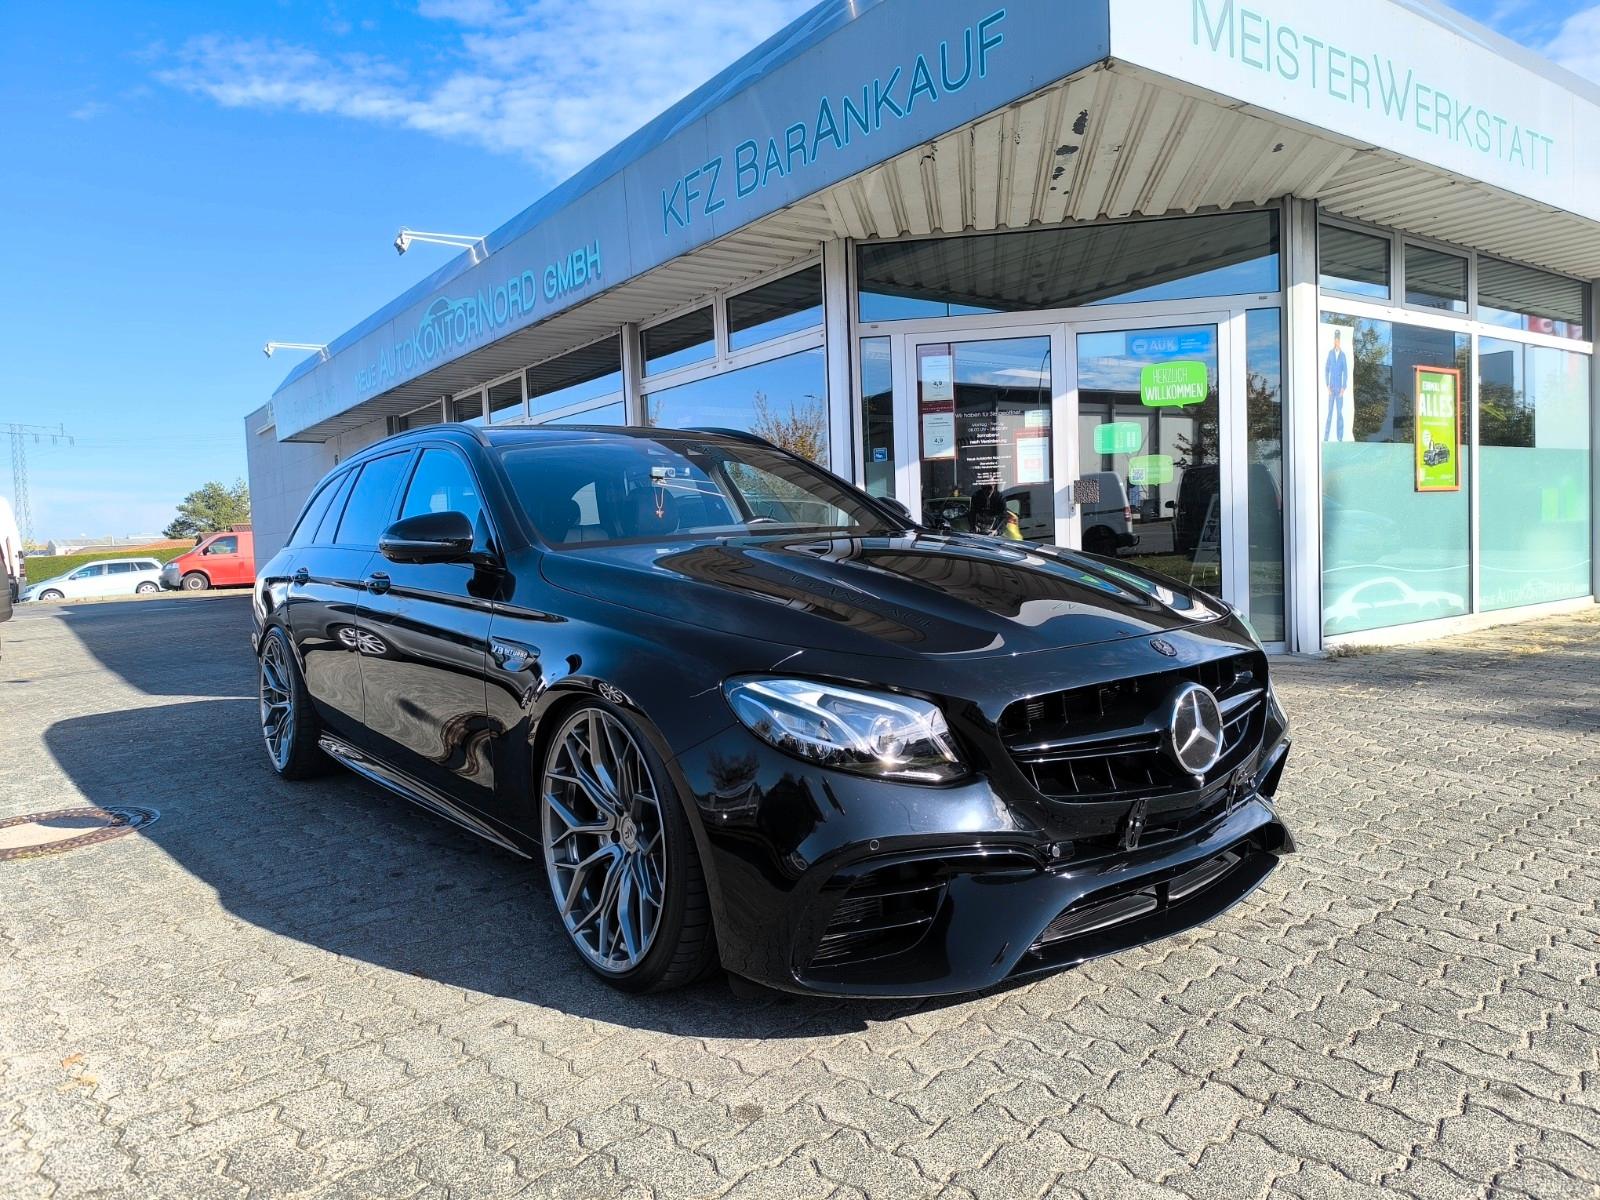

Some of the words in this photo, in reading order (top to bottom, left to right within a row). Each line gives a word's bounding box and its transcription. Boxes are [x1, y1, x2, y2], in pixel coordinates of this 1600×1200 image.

[660, 155, 725, 235] KFZ
[1152, 367, 1188, 384] HERZLICH
[1144, 382, 1204, 401] WILLKOMMEN
[491, 643, 503, 654] V8
